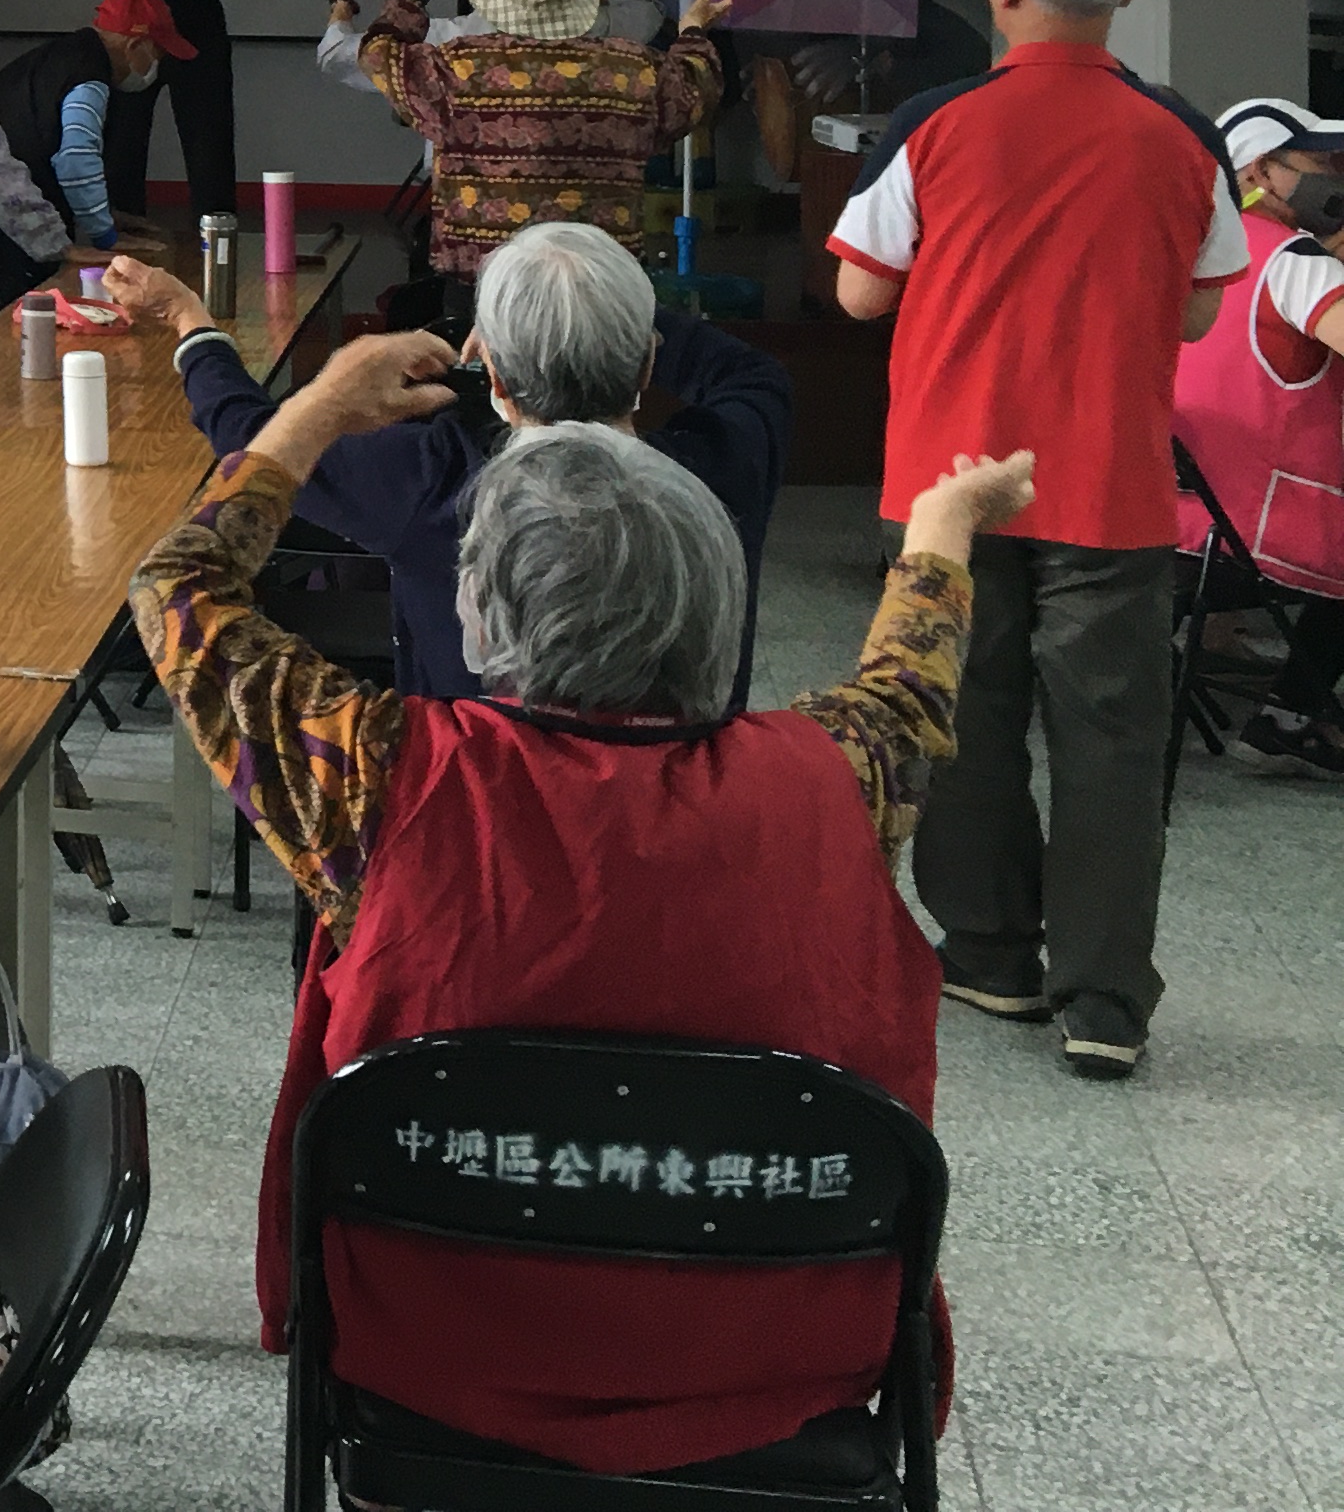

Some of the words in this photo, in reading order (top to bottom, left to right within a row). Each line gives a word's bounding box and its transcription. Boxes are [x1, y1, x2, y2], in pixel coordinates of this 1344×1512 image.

[395, 1120, 854, 1200] 中壢區公所東興社區
